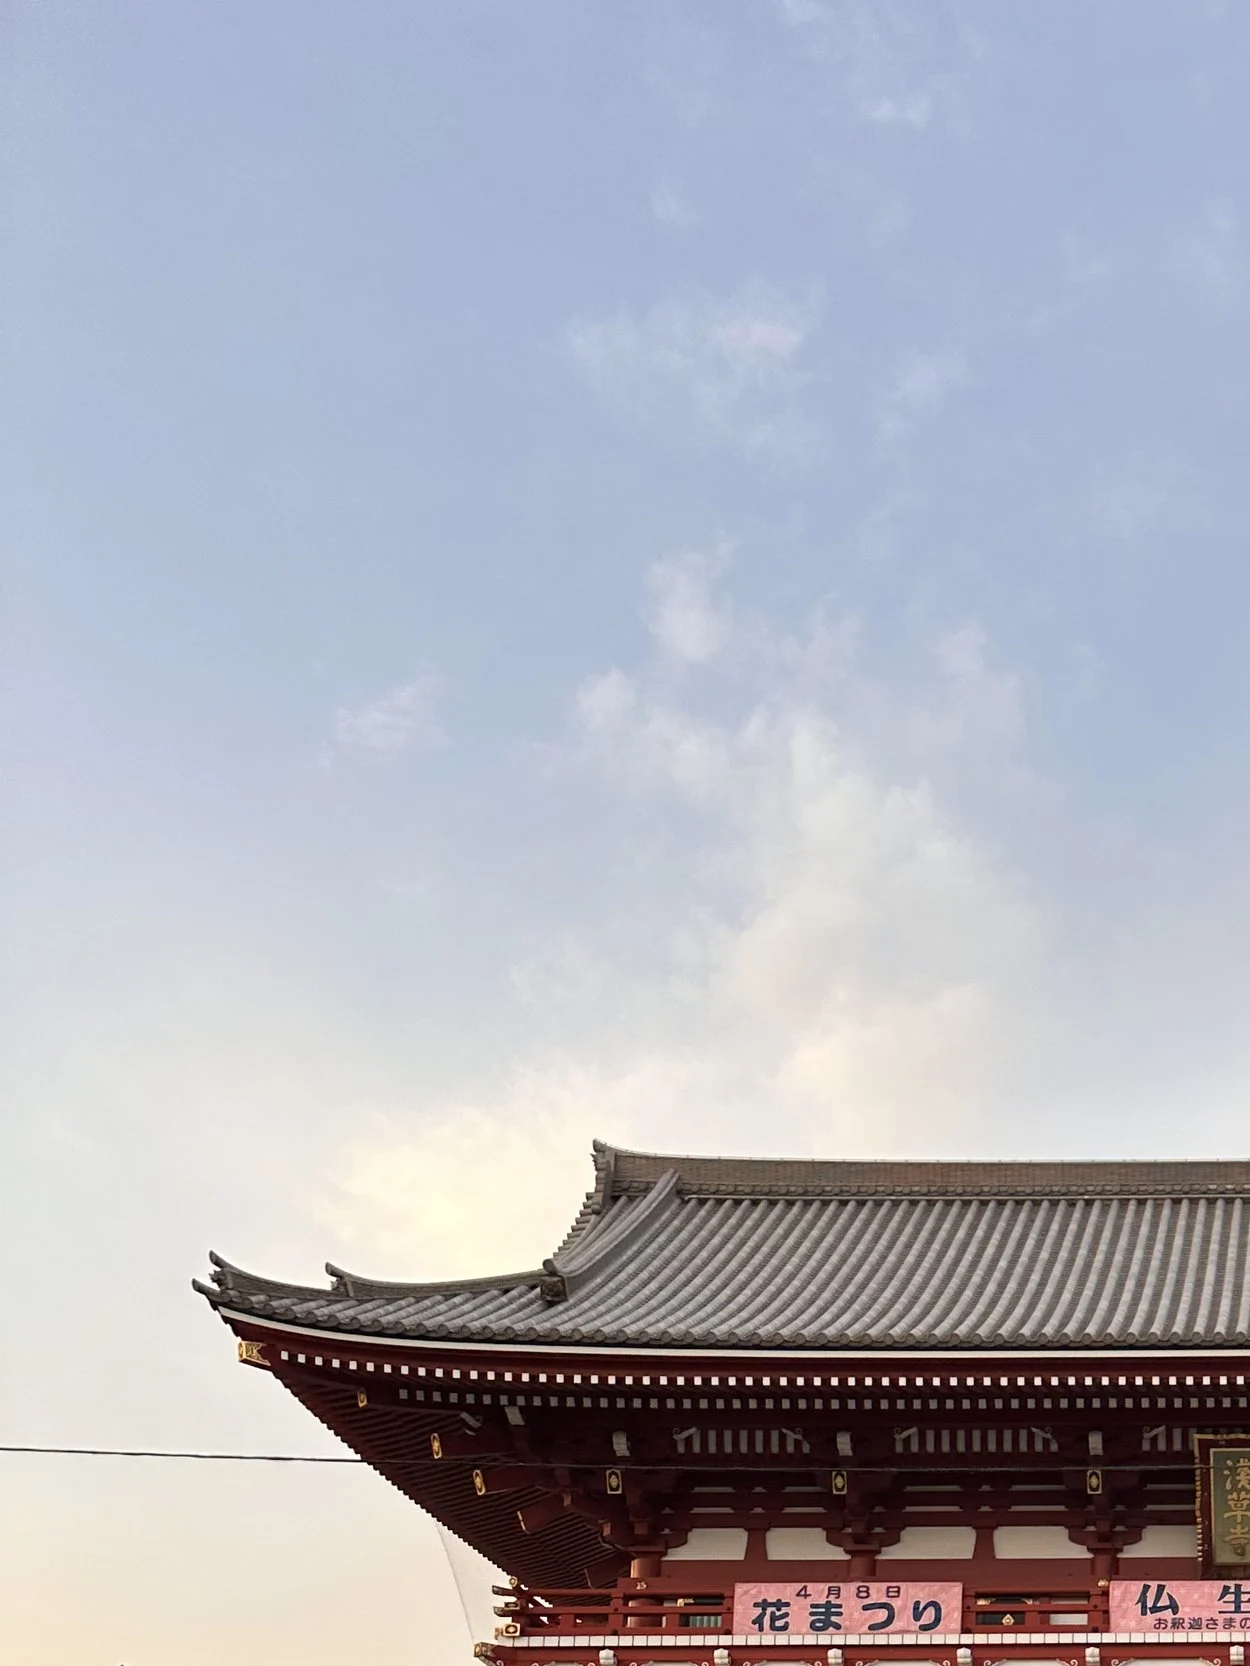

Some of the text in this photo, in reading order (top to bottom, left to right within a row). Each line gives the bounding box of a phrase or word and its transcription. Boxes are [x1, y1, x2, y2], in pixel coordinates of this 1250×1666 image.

[795, 1584, 902, 1600] 4月8日
[751, 1598, 943, 1632] 花まつり
